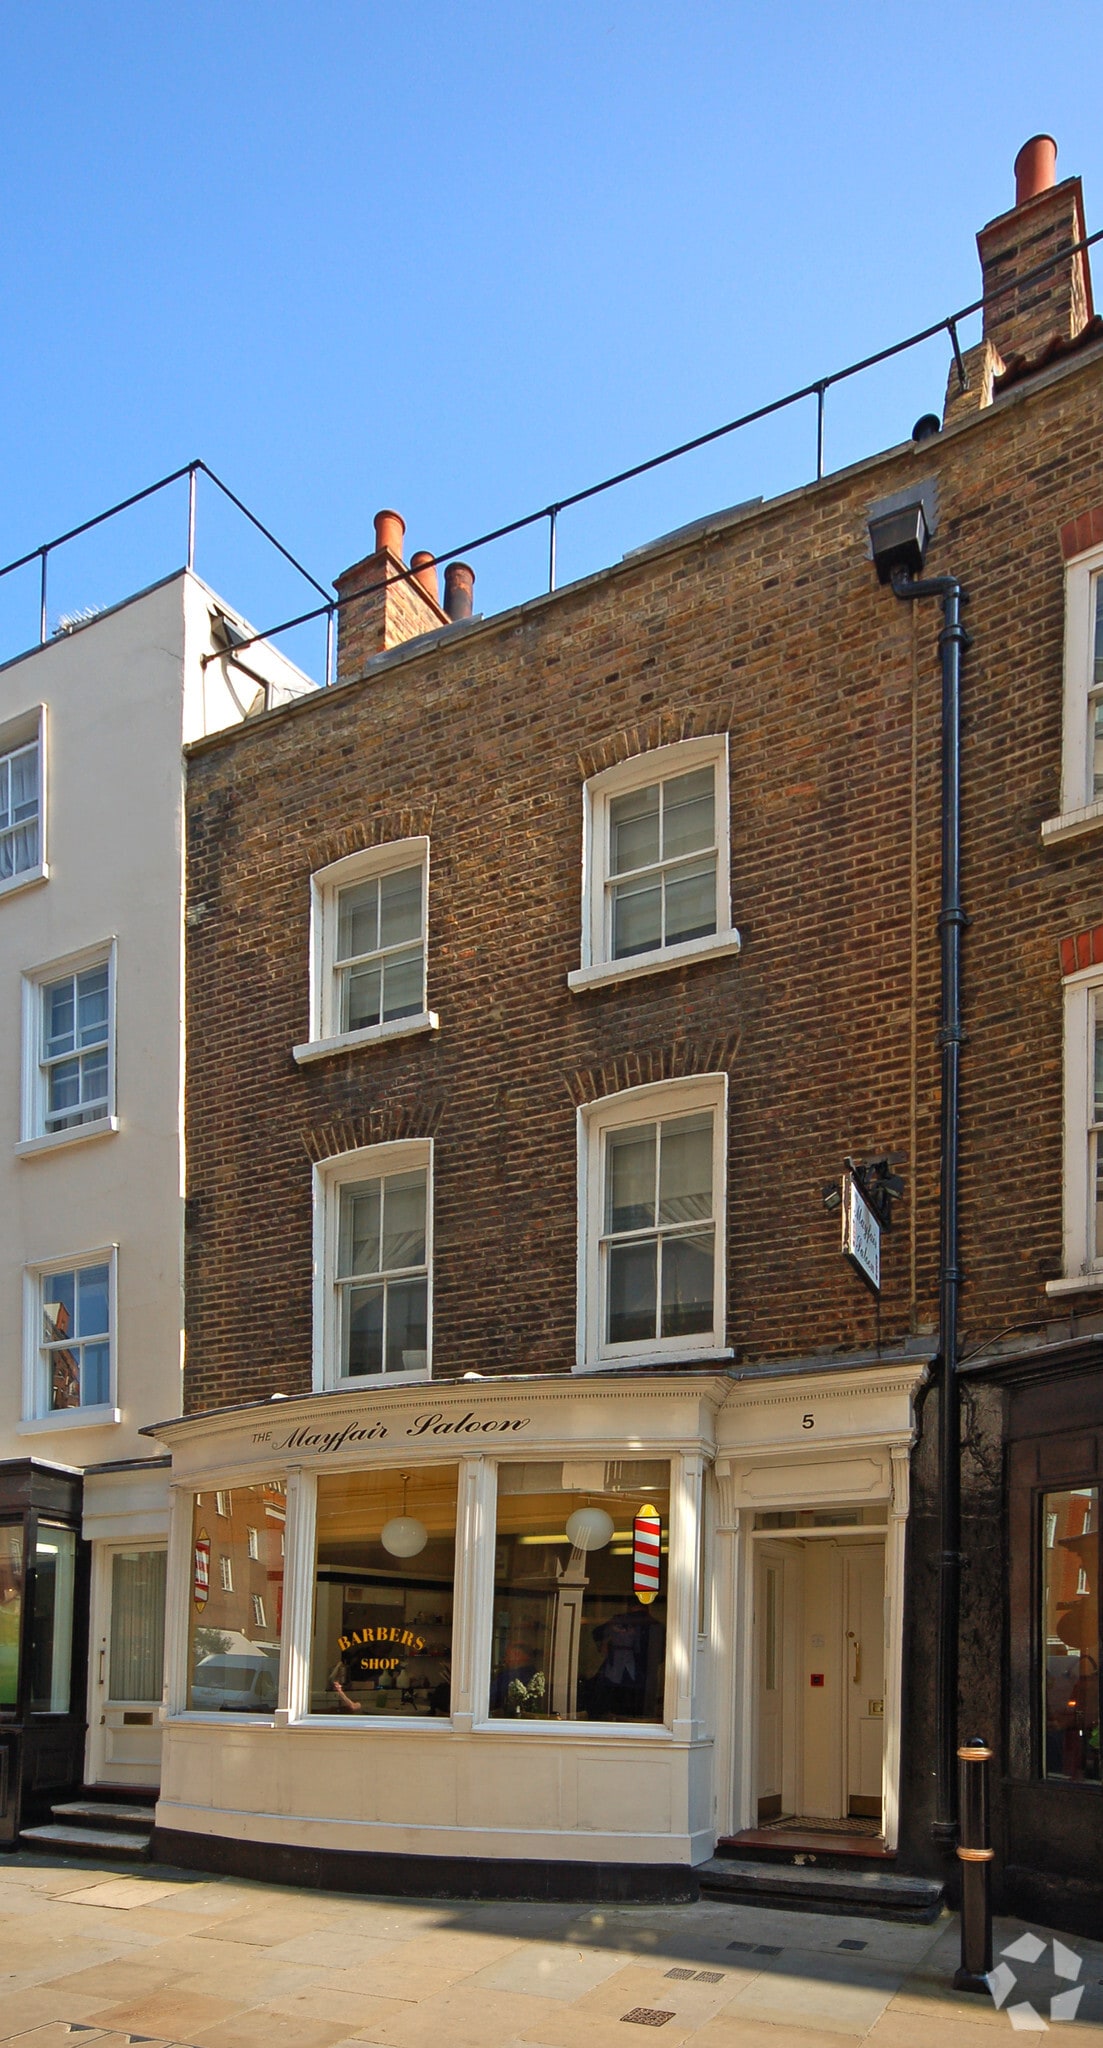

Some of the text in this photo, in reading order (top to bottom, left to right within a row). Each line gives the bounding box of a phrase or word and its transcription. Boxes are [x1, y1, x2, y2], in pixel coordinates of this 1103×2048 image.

[802, 1414, 814, 1429] 5
[252, 1412, 532, 1453] THE Mayfair Saloon
[337, 1626, 426, 1651] BARBERS
[360, 1658, 399, 1670] SHOP
